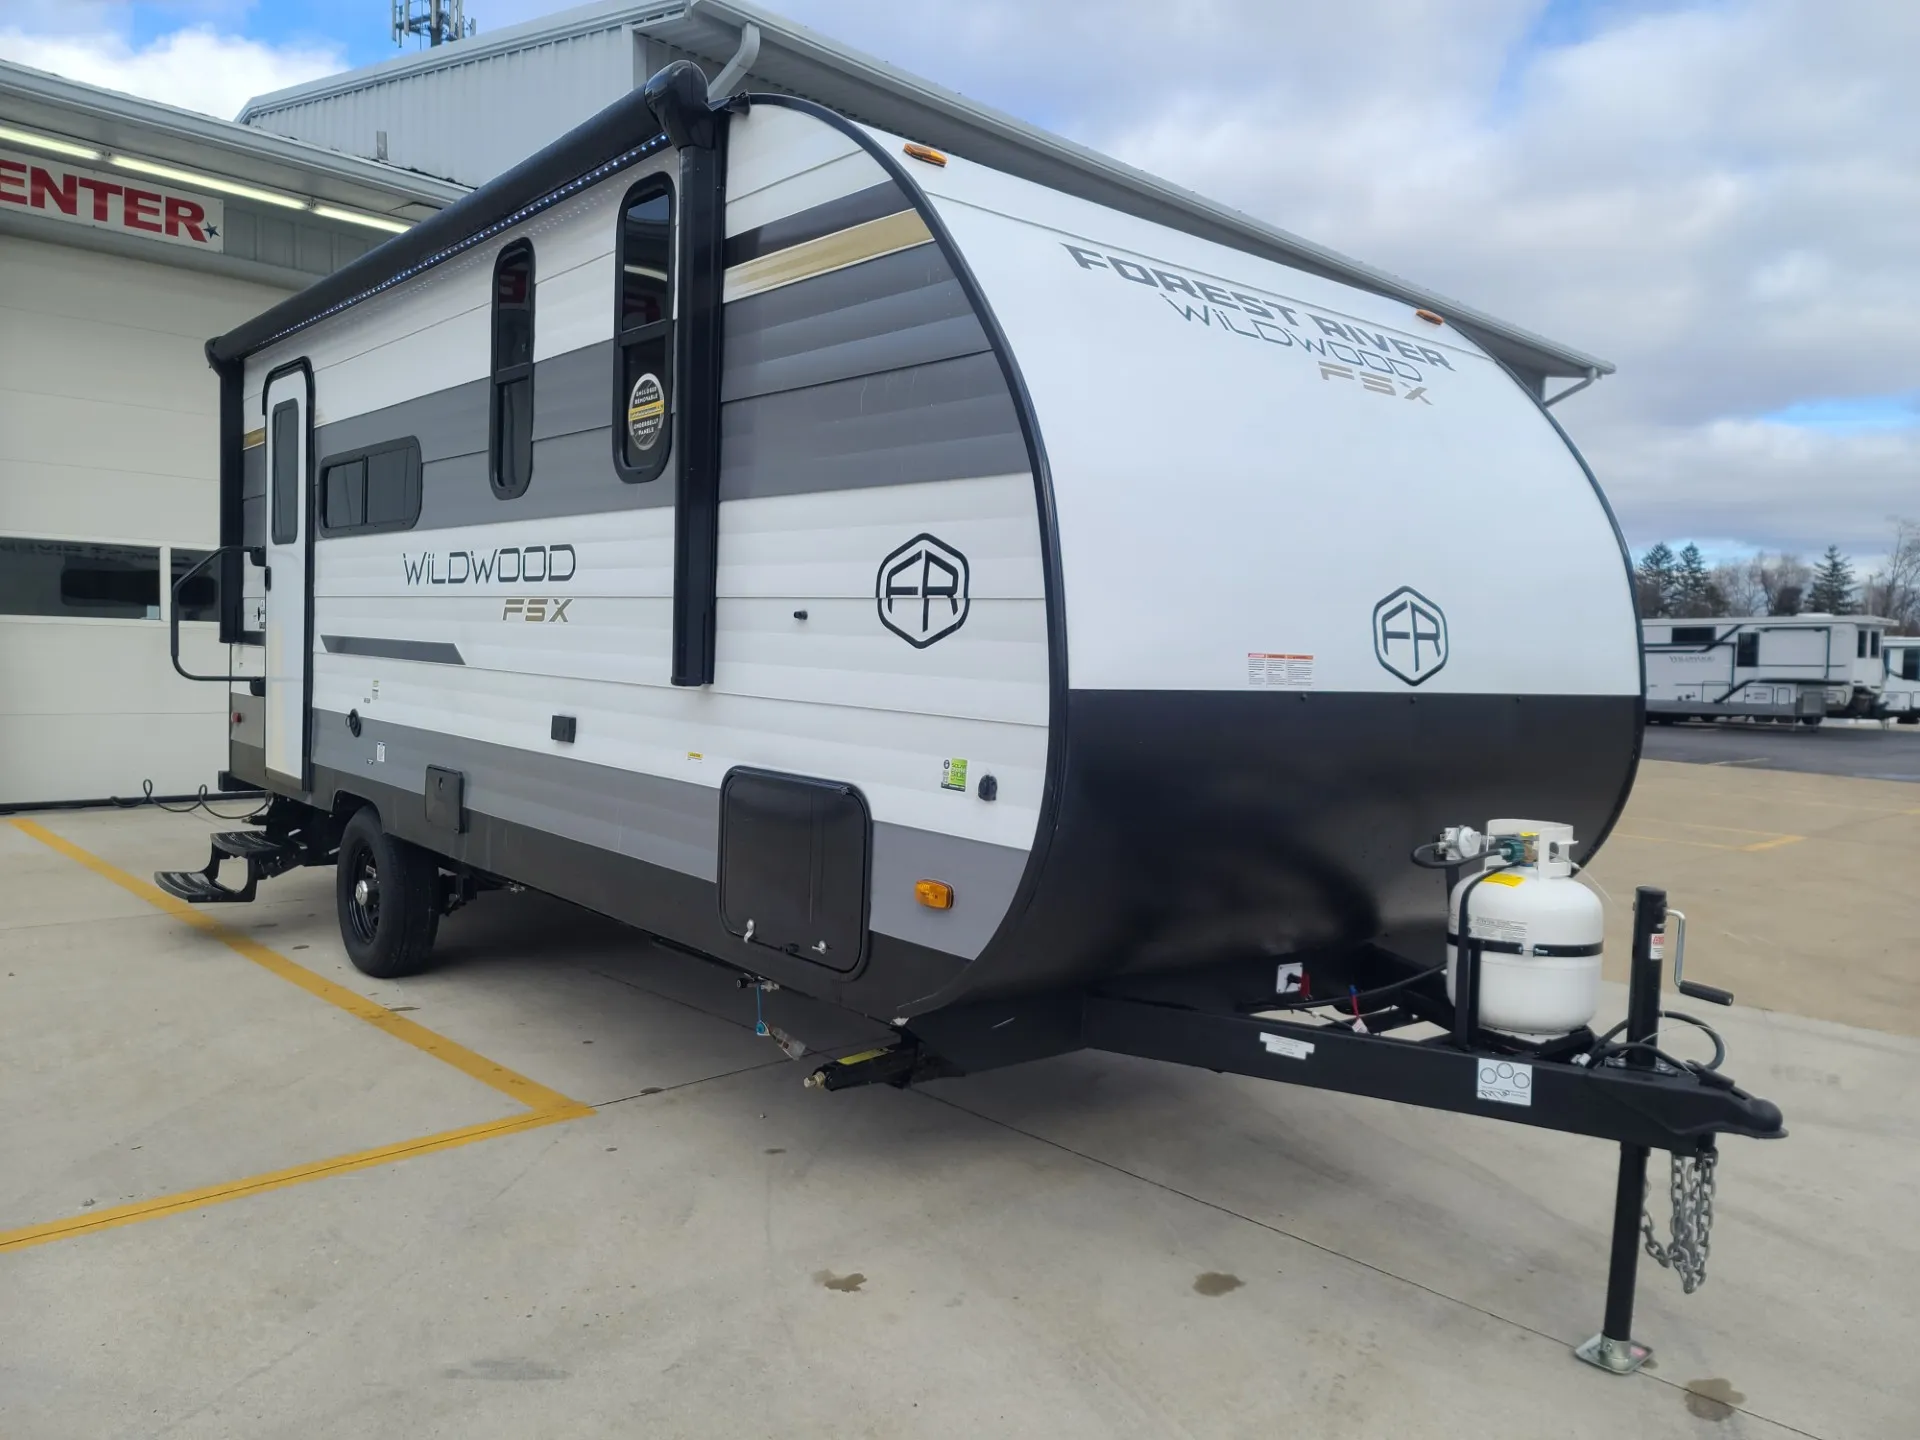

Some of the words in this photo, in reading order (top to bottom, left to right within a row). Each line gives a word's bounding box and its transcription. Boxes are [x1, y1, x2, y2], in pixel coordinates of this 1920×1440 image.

[1060, 242, 1300, 327] FOREST
[1305, 312, 1457, 372] RIVER
[1159, 292, 1423, 383] WILDWOOD
[1317, 360, 1433, 406] FSX
[402, 544, 577, 586] WILDWOOD
[502, 598, 573, 623] FSX
